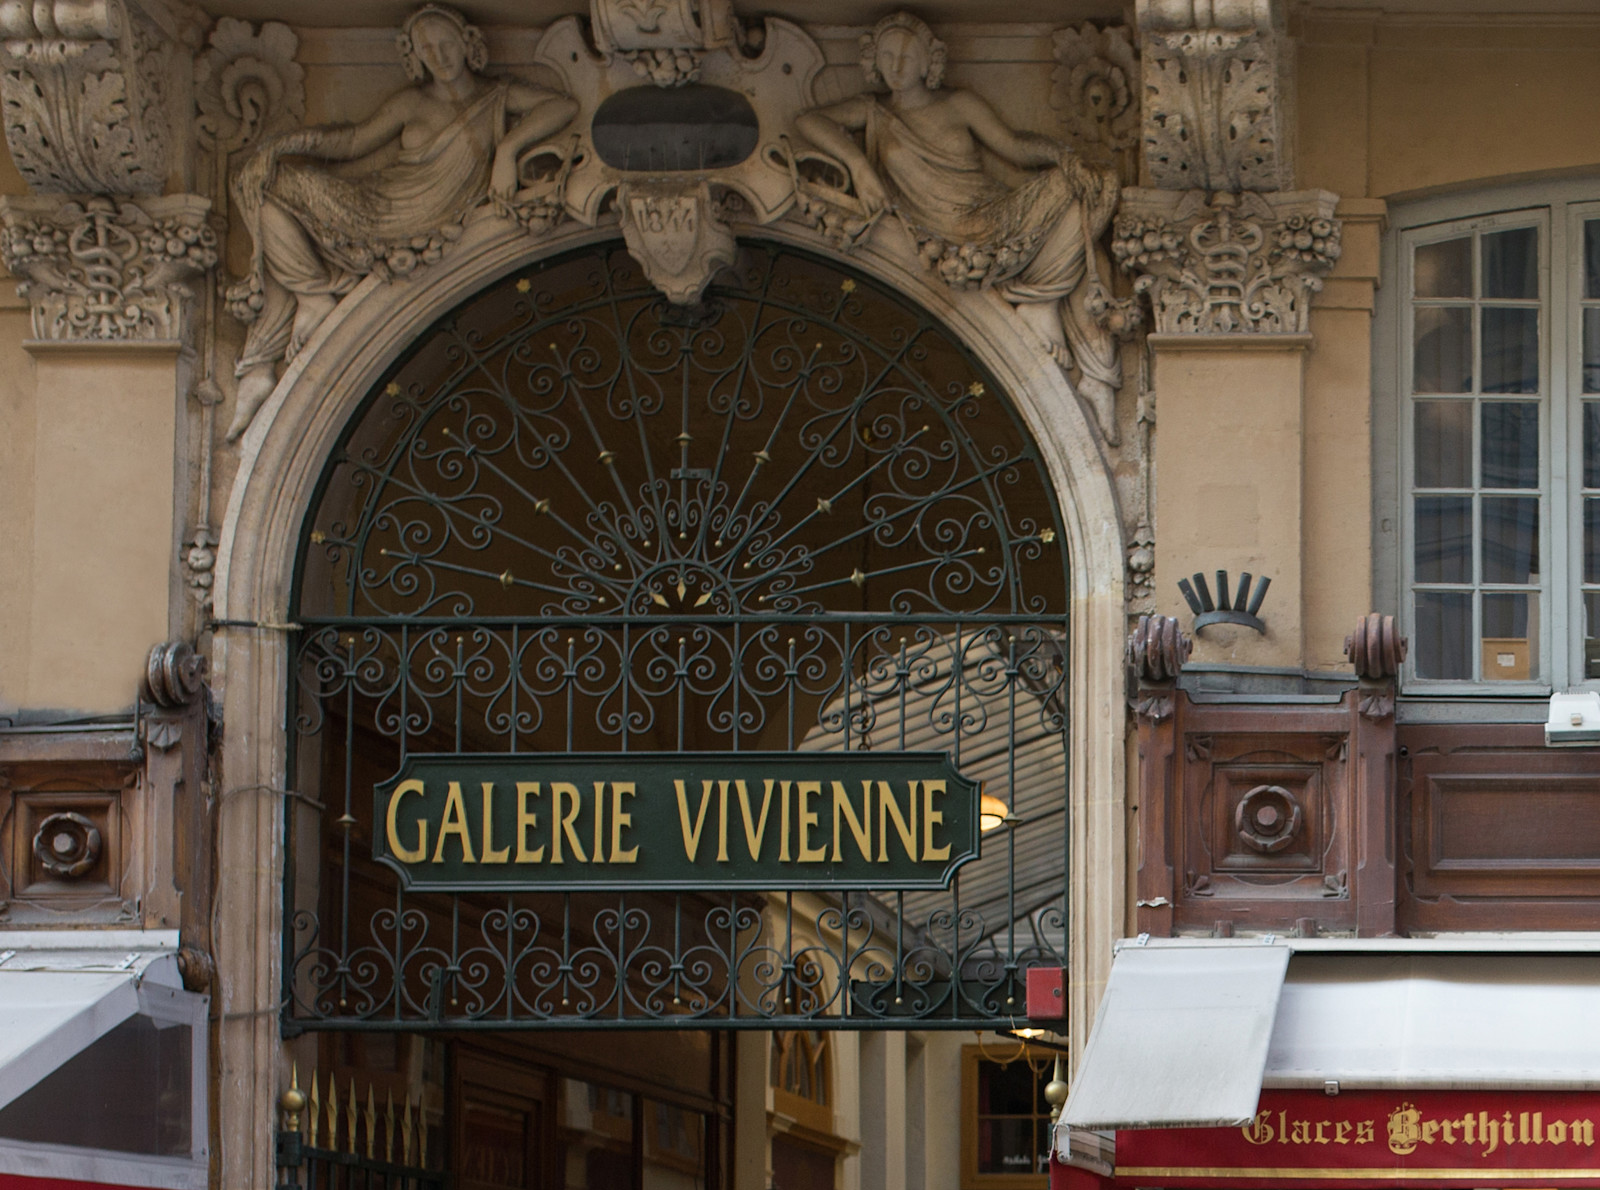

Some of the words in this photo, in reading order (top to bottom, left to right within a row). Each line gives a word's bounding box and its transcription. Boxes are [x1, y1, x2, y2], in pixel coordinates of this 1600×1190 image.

[386, 779, 640, 864] GALERIE
[674, 779, 953, 863] VIVIENNE
[1242, 1109, 1375, 1146] Glaces
[1386, 1101, 1596, 1158] Berthillon
